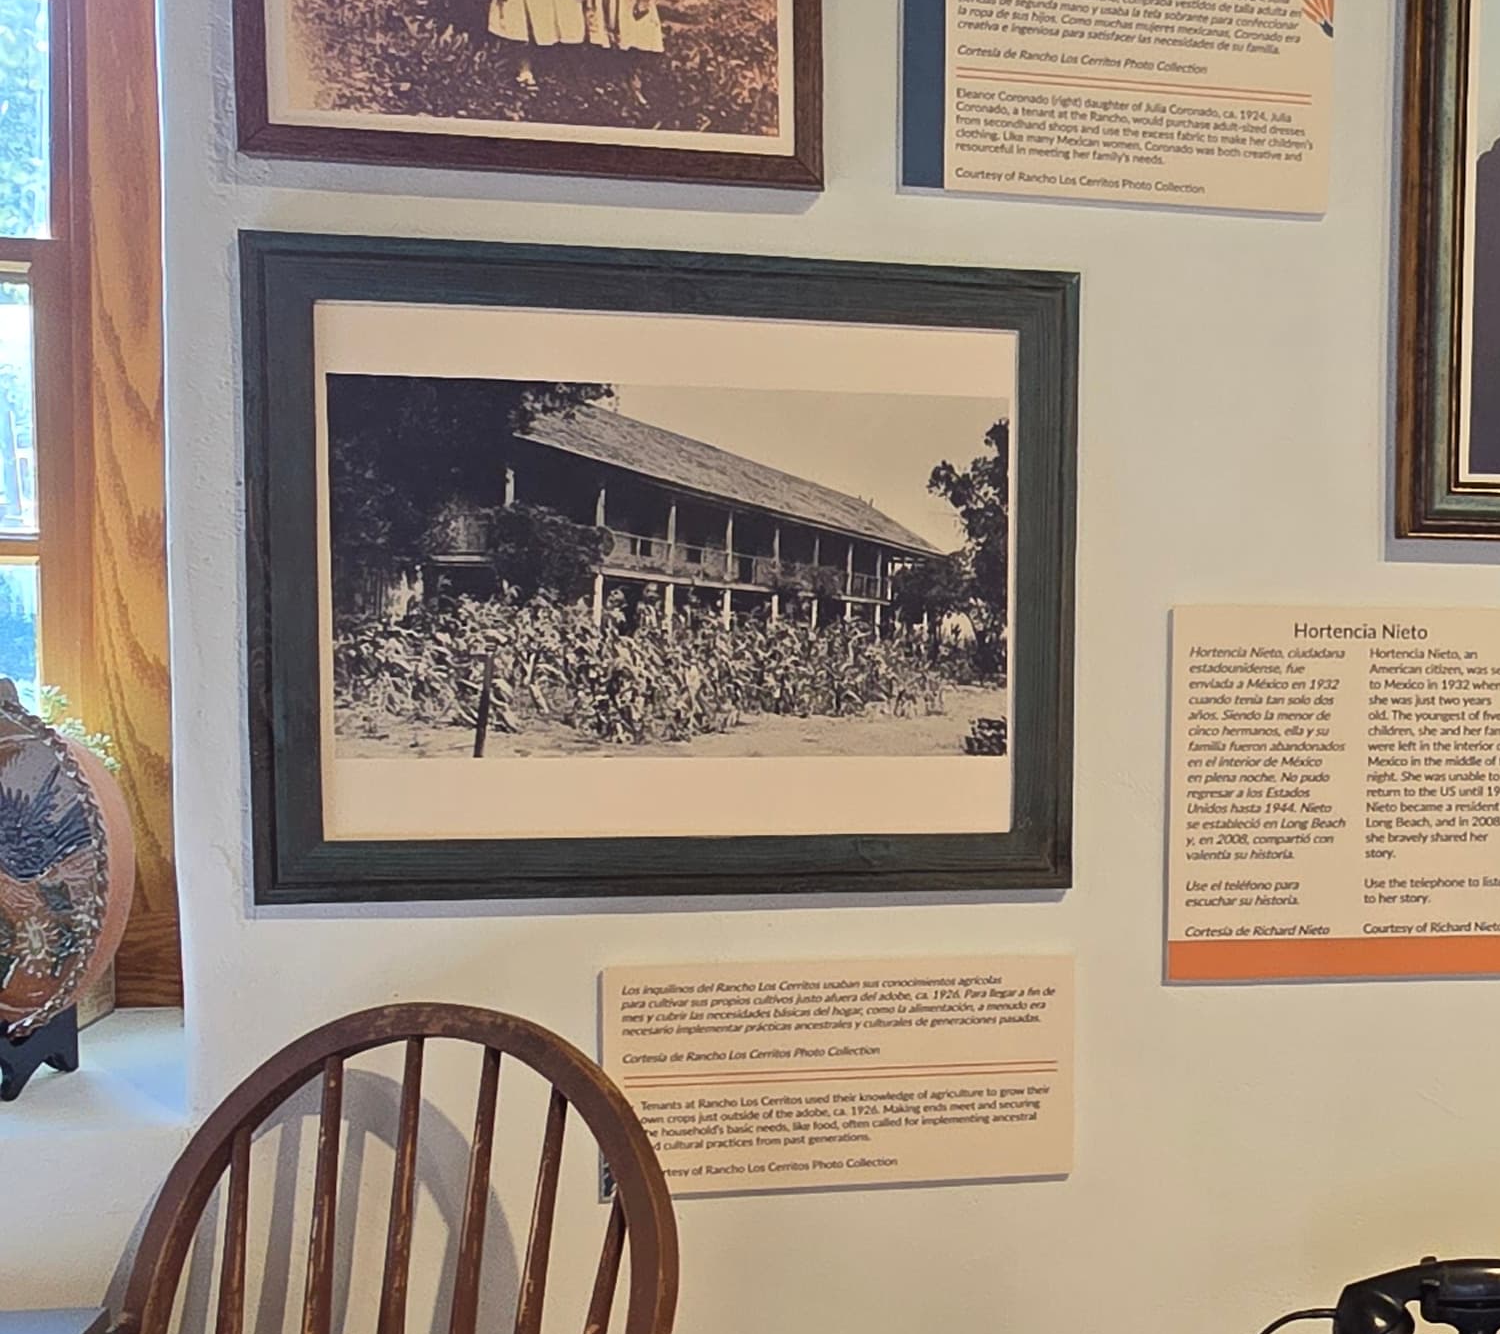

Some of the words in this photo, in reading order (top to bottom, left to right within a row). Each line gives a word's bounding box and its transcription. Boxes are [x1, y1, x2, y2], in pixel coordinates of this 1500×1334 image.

[1294, 622, 1377, 640] Hortencia
[1382, 623, 1428, 640] Nieto
[1189, 646, 1248, 658] Hortencia
[1287, 647, 1346, 660] ciudadana
[1369, 647, 1425, 660] Hortencia
[1463, 651, 1478, 660] an
[1368, 662, 1423, 675] American
[1466, 666, 1489, 675] was
[1188, 678, 1235, 690] enviada
[1246, 678, 1290, 690] México
[1291, 681, 1307, 690] en
[1309, 678, 1340, 691] 1932
[1369, 680, 1382, 690] to
[1383, 678, 1425, 690] Mexico
[1427, 678, 1439, 690] in
[1442, 679, 1470, 691] 1932
[1368, 694, 1389, 706] she
[1390, 697, 1413, 706] was
[1414, 694, 1436, 708] just
[1438, 695, 1461, 706] two
[1462, 697, 1493, 708] years
[1185, 880, 1209, 892] Use
[1209, 880, 1223, 892] el
[1223, 879, 1273, 892] teléfono
[1273, 881, 1300, 892] para
[1364, 878, 1386, 889] Use
[1388, 877, 1408, 889] the
[1409, 877, 1466, 890] telephone
[1467, 877, 1480, 888] to
[1363, 894, 1377, 904] to
[1378, 892, 1398, 904] her
[1184, 926, 1234, 938] Cortesía
[1235, 926, 1251, 936] de
[1252, 925, 1297, 936] Richard
[1298, 924, 1331, 936] Nieto
[1362, 922, 1414, 935] Courtesy
[1415, 922, 1428, 933] of
[1430, 921, 1472, 933] Richard
[621, 1052, 668, 1064] Cortesía
[669, 1052, 685, 1063] de
[685, 1050, 727, 1062] Rancho
[728, 1050, 747, 1061] Los
[748, 1048, 792, 1060] Cerritos
[793, 1047, 826, 1058] Photo
[827, 1046, 881, 1057] Collection
[640, 1100, 683, 1111] Tenants
[697, 1098, 739, 1109] Rancho
[740, 1097, 759, 1108] Los
[760, 1095, 803, 1107] Cerritos
[804, 1094, 830, 1105] used
[832, 1092, 857, 1103] their
[859, 1091, 915, 1102] knowledge
[916, 1090, 928, 1100] of
[929, 1089, 984, 1101] agriculture
[985, 1087, 998, 1097] to
[999, 1088, 1025, 1098] grow
[1026, 1086, 1050, 1095] their
